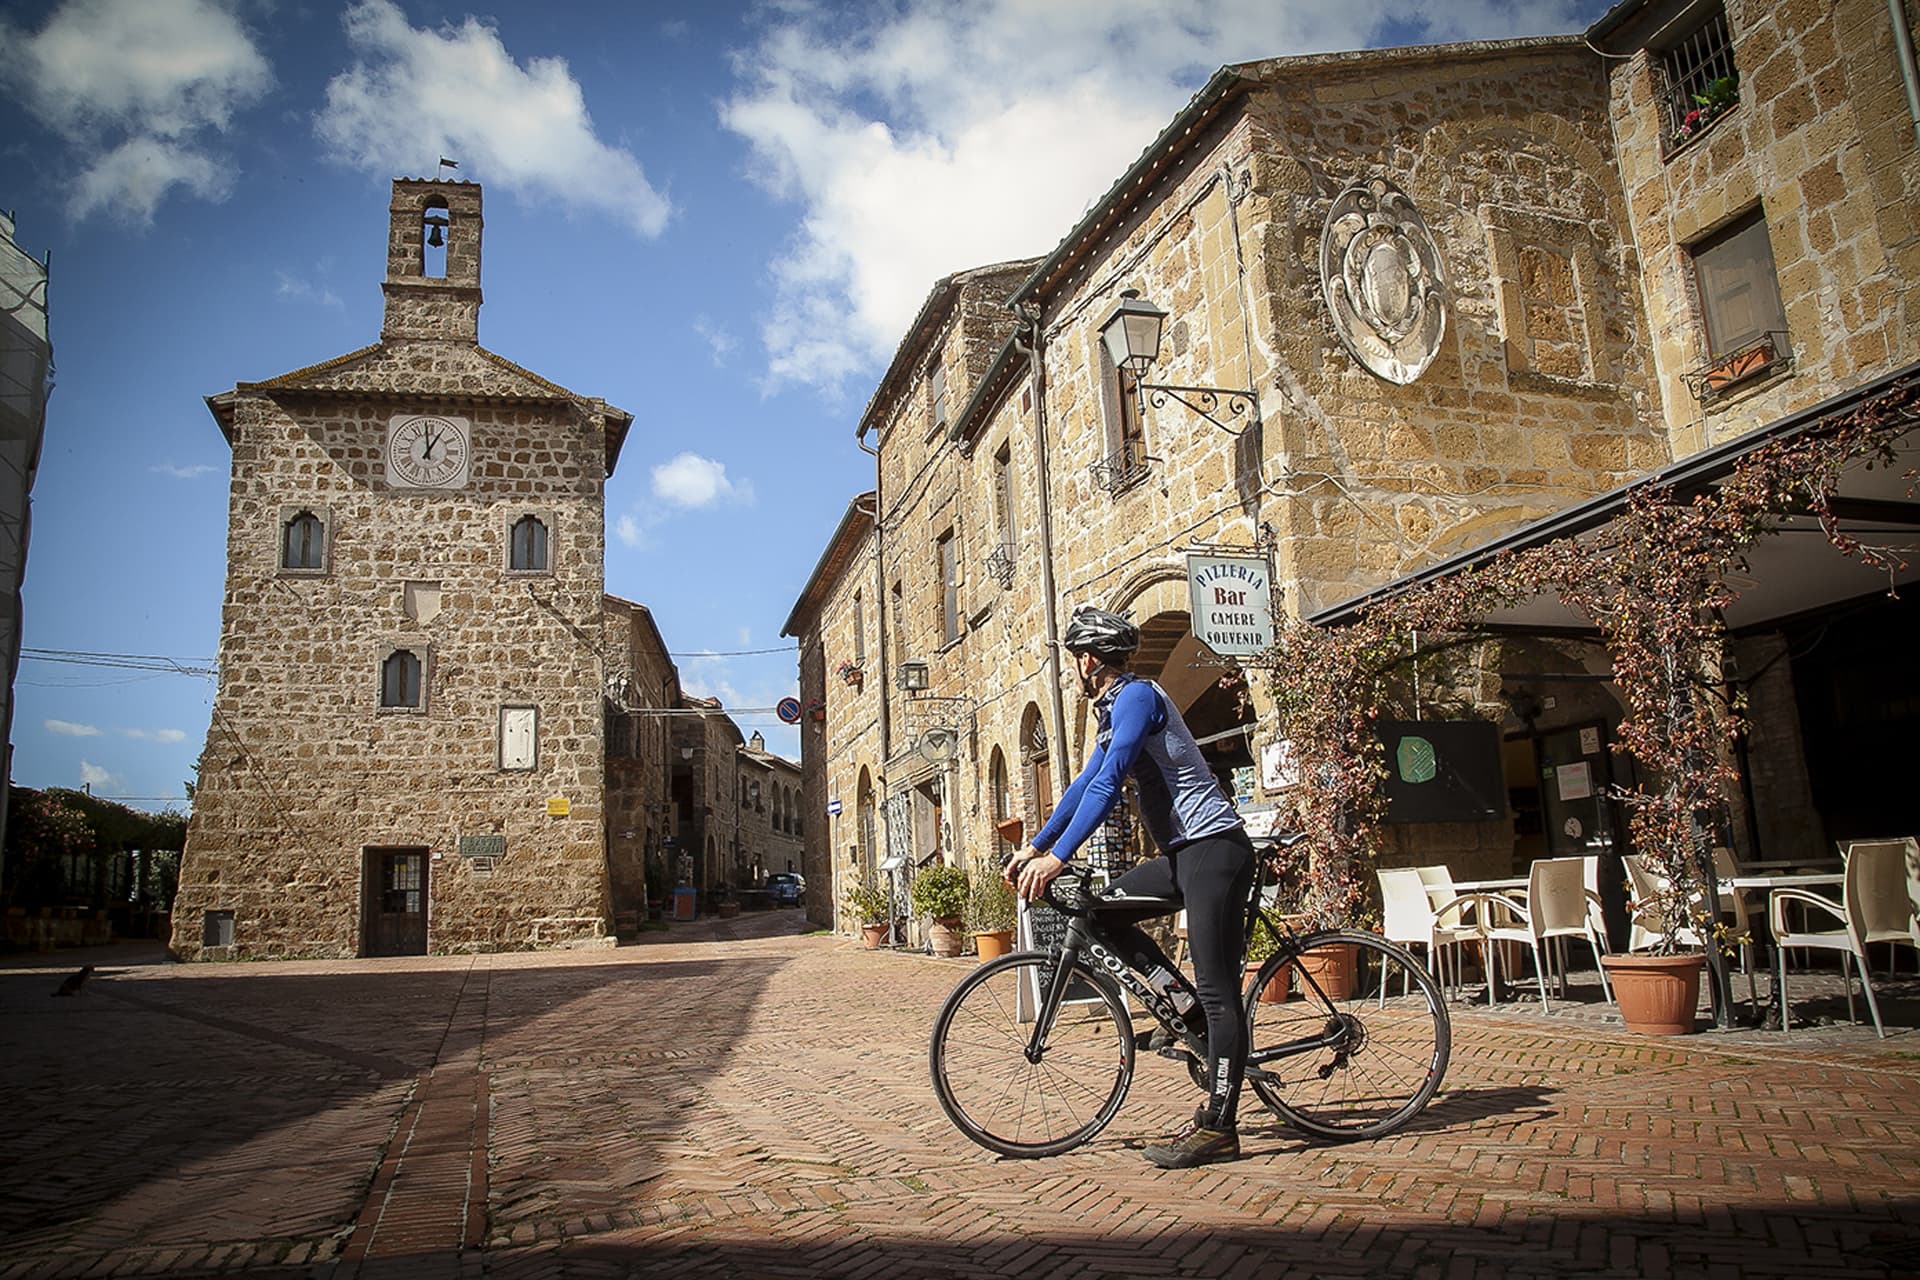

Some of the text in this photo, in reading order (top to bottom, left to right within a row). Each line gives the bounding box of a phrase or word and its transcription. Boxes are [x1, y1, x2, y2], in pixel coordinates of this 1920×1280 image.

[1195, 564, 1263, 590] PIZZERIA
[1214, 587, 1247, 606] Bar
[1211, 612, 1256, 626] CAMERE
[1206, 631, 1264, 646] SOUVENIR
[662, 804, 671, 835] BAR
[1090, 944, 1188, 1034] COLNAGO
